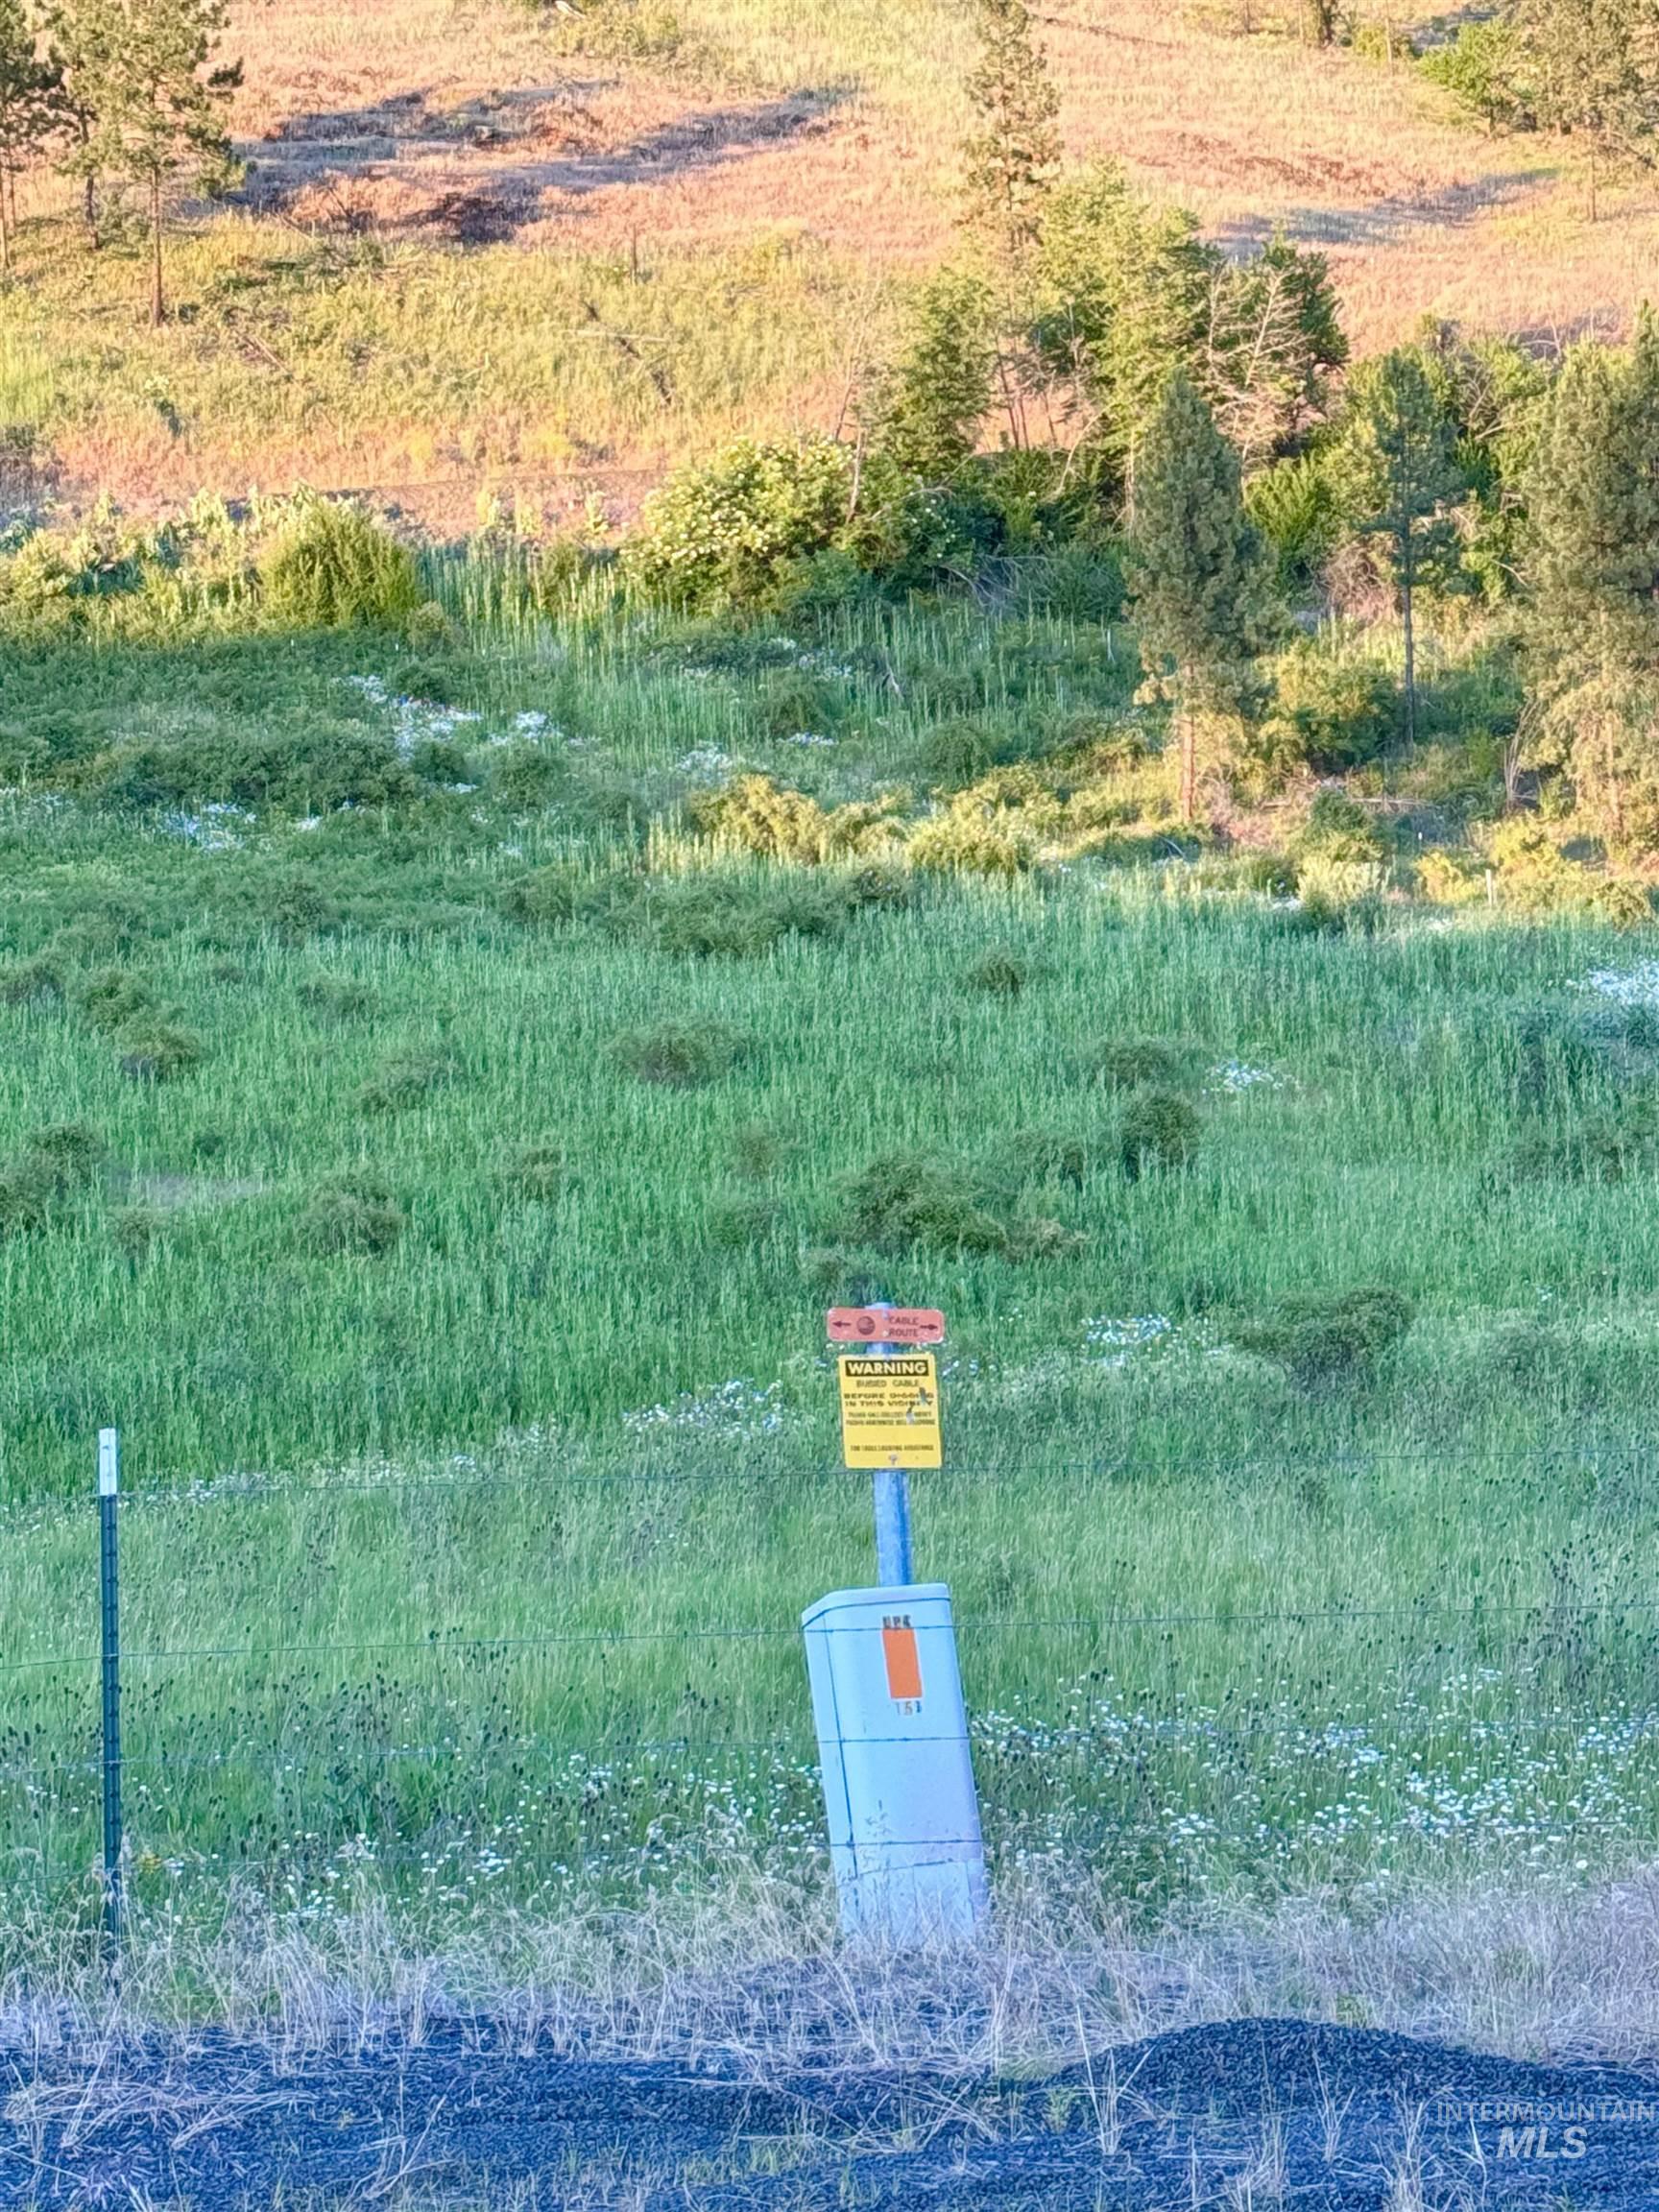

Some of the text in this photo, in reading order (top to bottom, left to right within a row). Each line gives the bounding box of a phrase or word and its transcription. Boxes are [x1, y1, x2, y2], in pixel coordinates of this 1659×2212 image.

[888, 1316, 919, 1325] CABLE
[889, 1329, 919, 1337] ROUTE
[846, 1361, 926, 1375] WARNING
